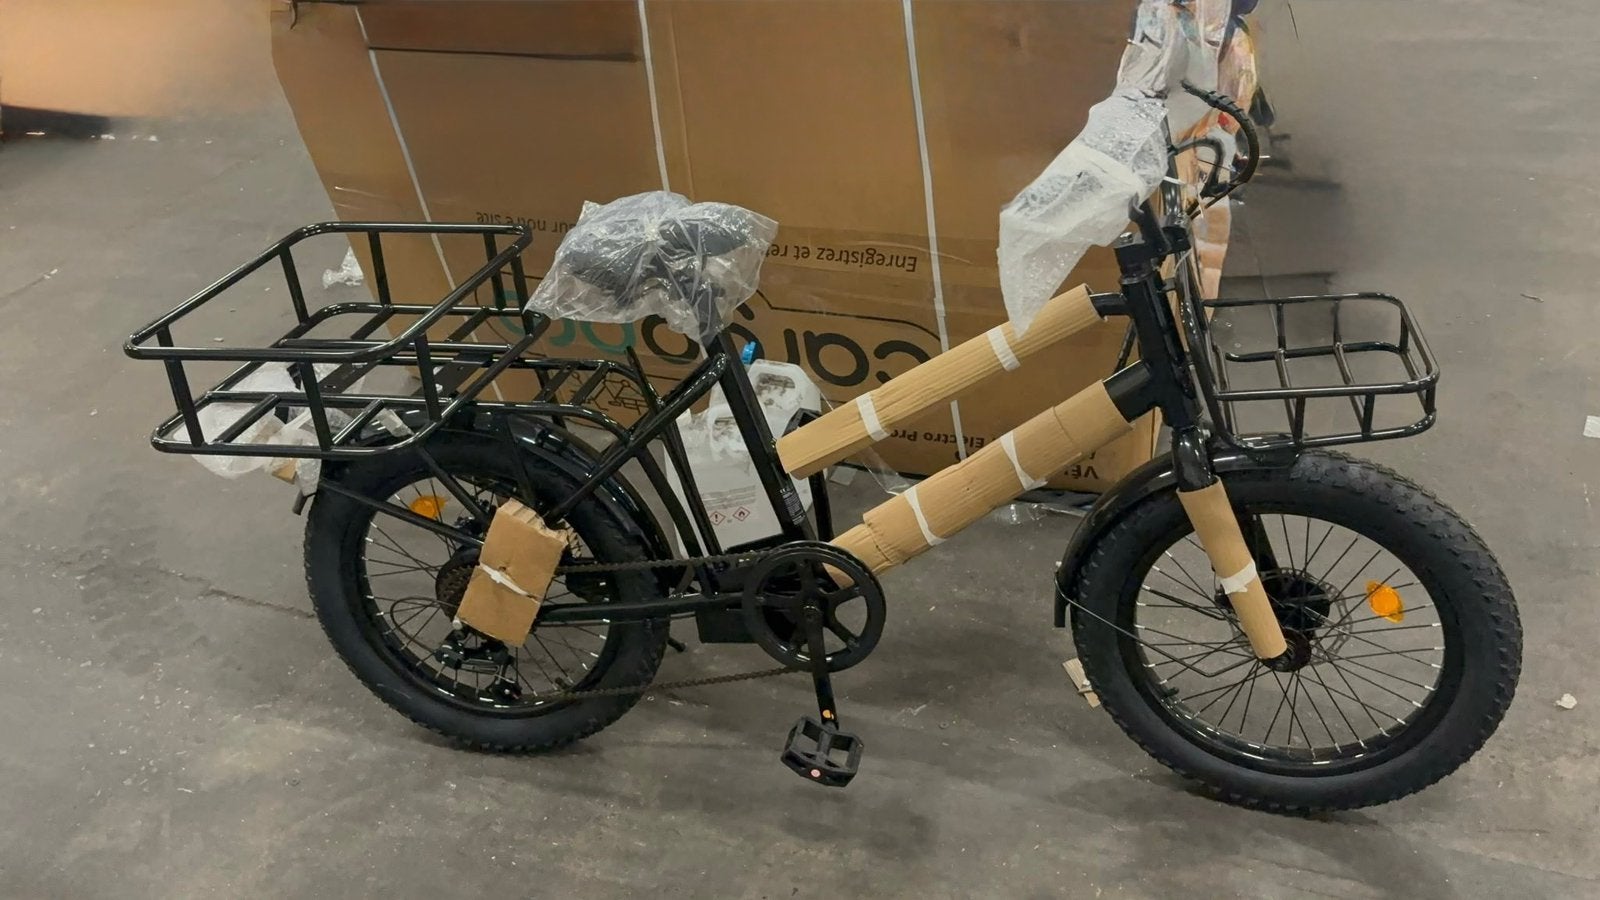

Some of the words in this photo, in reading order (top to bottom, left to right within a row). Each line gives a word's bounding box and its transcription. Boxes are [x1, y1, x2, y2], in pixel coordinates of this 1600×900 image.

[551, 218, 576, 233] ur
[794, 245, 810, 260] et
[816, 247, 918, 272] Enregistrez
[923, 431, 985, 449] Electro
[1064, 465, 1099, 480] VÉ
